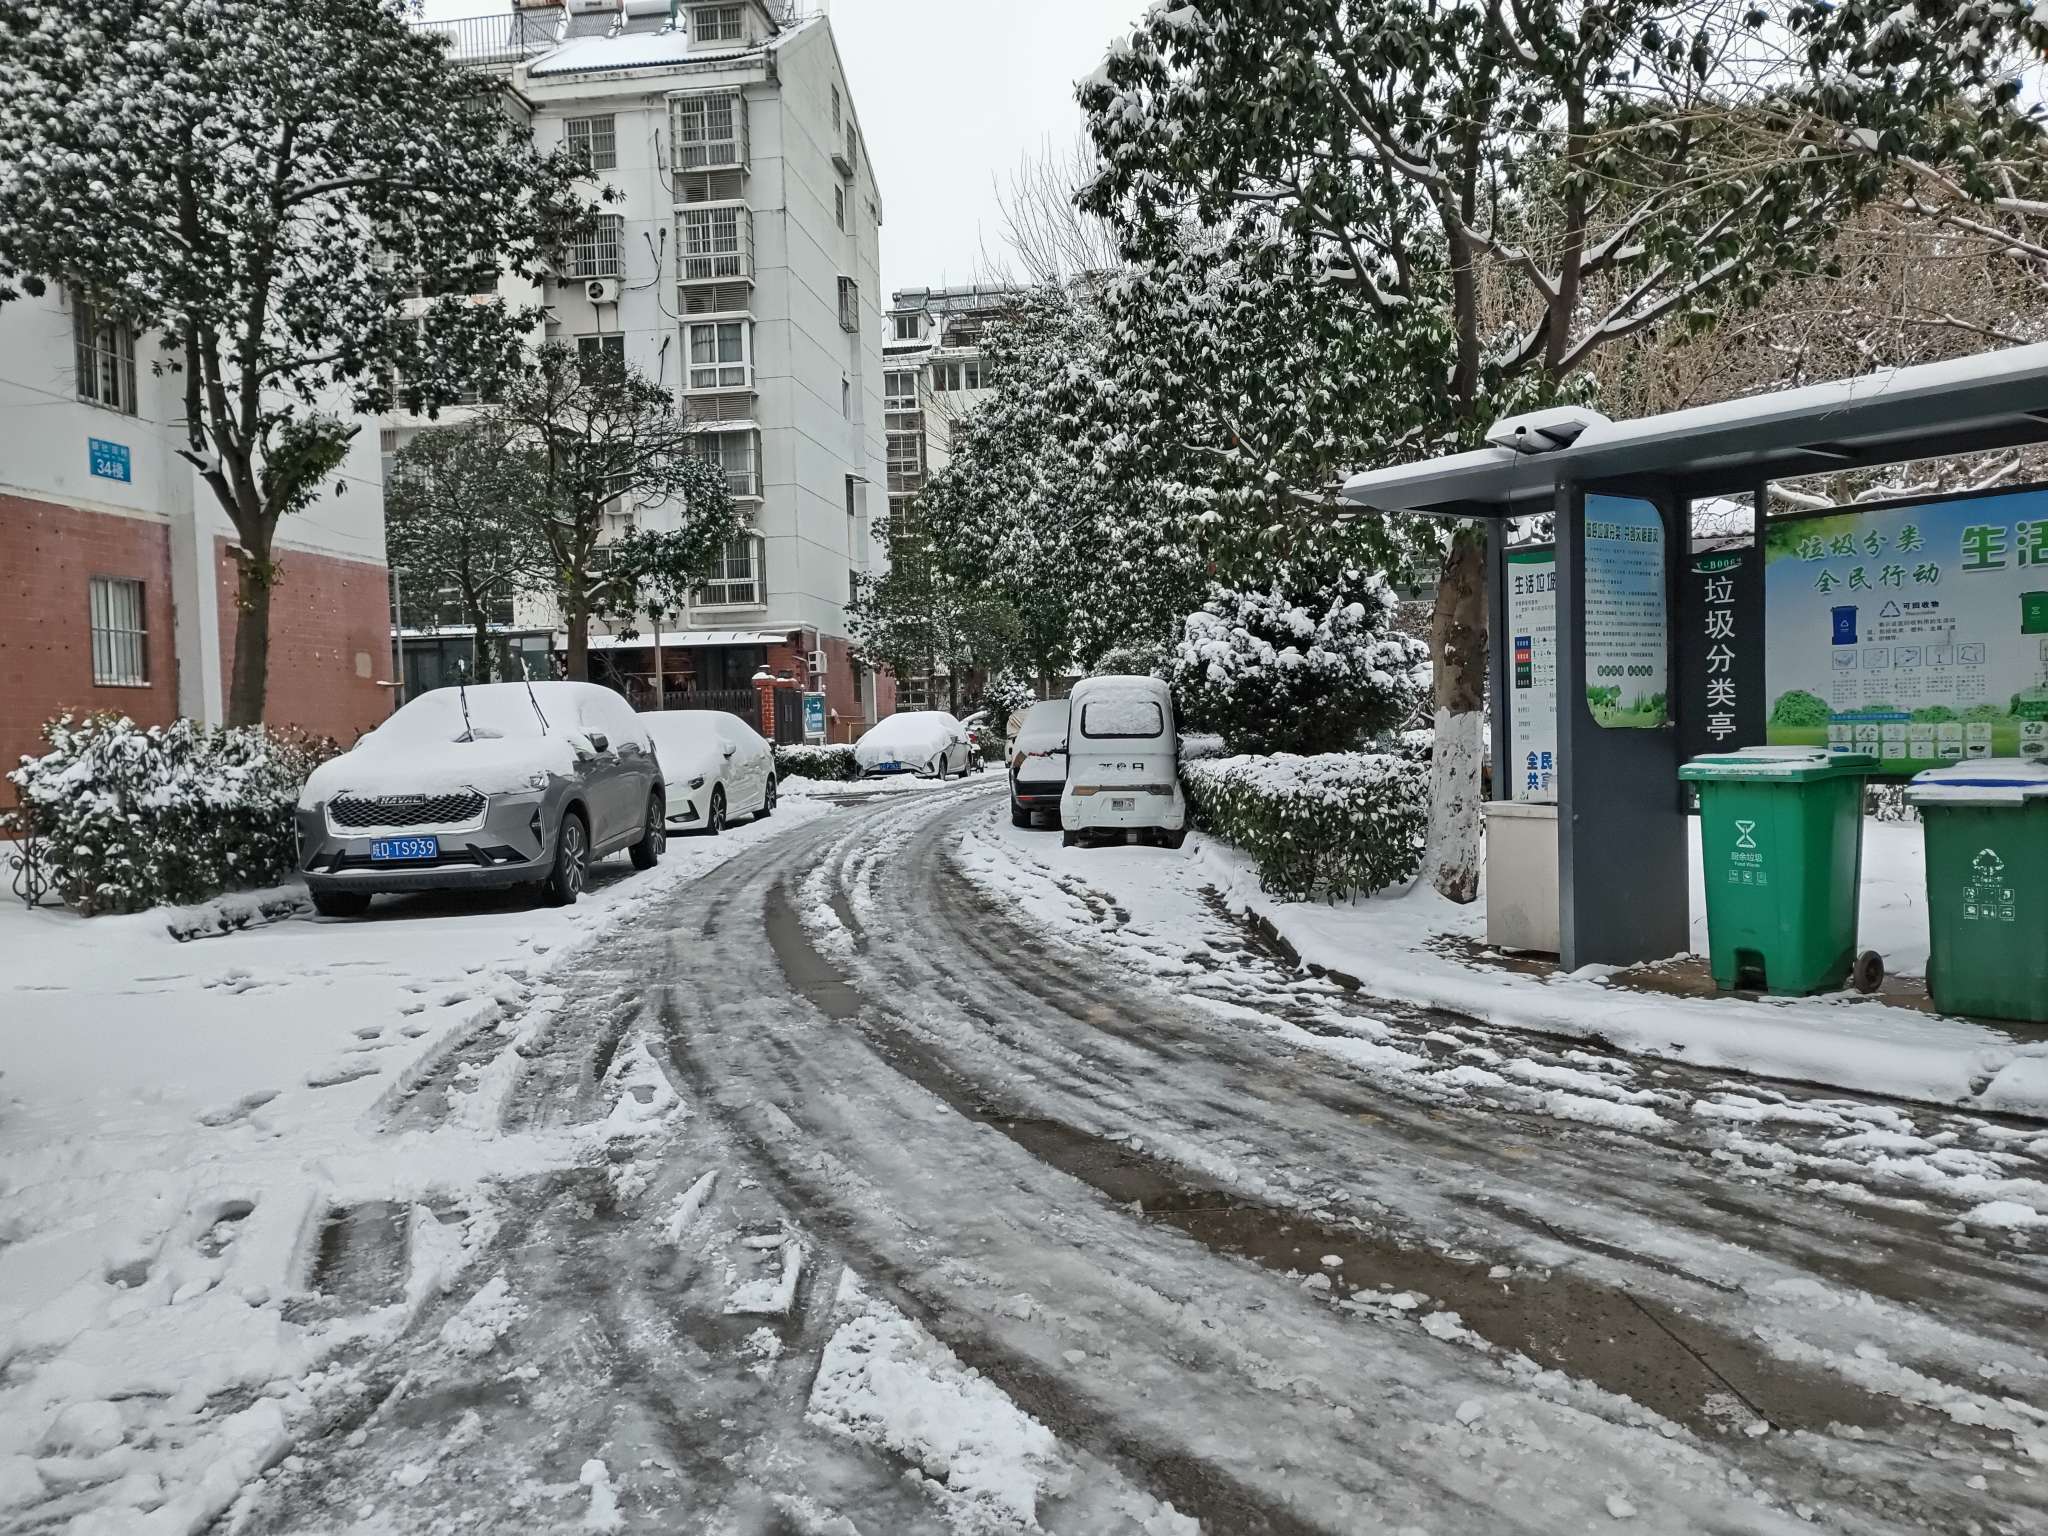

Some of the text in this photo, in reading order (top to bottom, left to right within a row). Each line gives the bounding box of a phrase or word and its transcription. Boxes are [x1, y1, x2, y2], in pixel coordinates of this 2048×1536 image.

[1799, 524, 1924, 561] 垃圾分类
[1961, 519, 2048, 571] 生活
[1814, 563, 1941, 593] 全民行动
[1903, 600, 1940, 610] 可回收物
[1704, 575, 1737, 741] 垃圾分类亭
[1527, 751, 1552, 770] 全民
[380, 797, 421, 805] HAVAL
